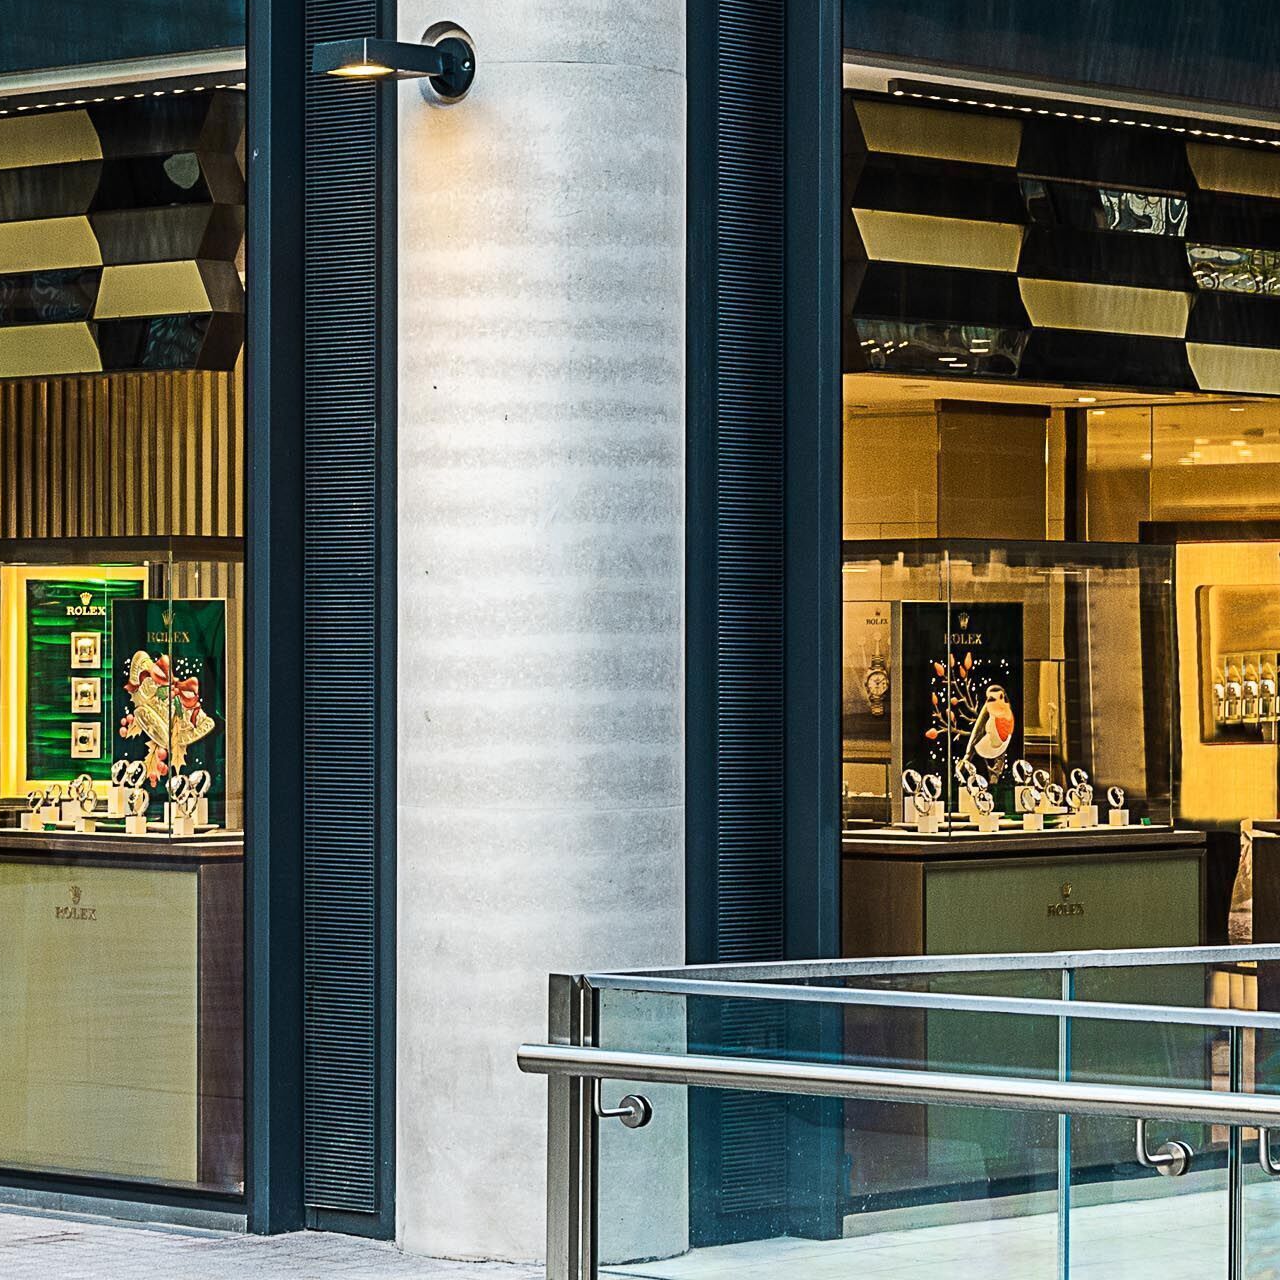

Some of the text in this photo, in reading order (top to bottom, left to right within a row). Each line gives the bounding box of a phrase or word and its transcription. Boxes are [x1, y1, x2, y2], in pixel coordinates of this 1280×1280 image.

[66, 606, 106, 616] ROLEX
[147, 631, 190, 643] ROLEX
[944, 633, 982, 645] ROLEX
[55, 906, 97, 920] ROLEX
